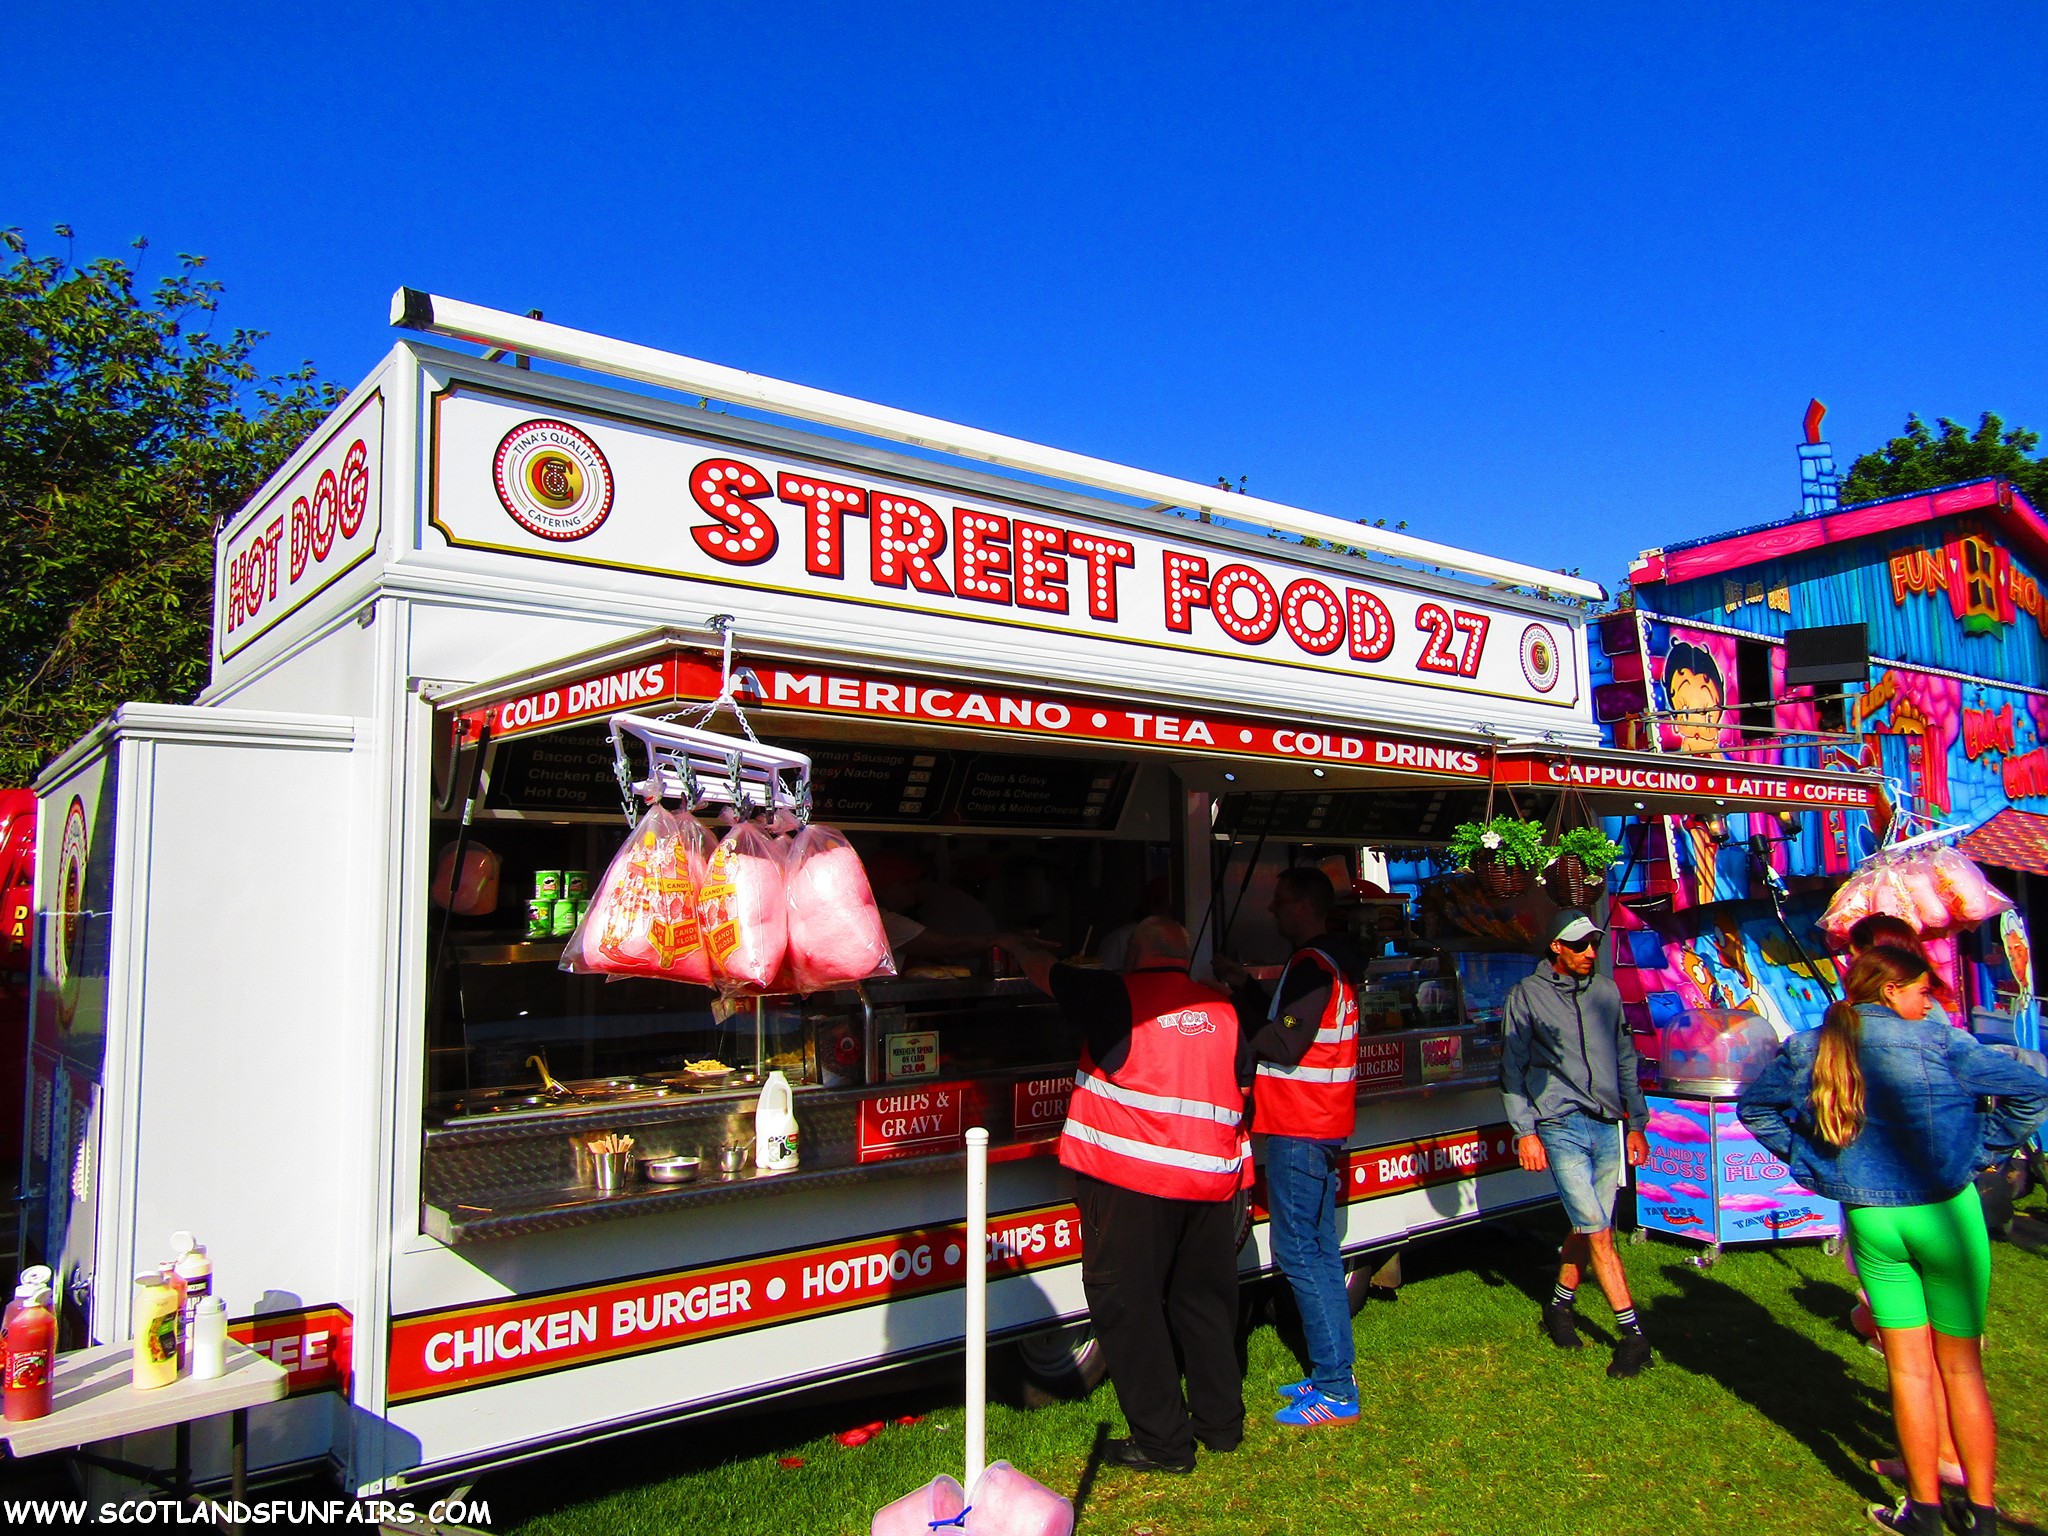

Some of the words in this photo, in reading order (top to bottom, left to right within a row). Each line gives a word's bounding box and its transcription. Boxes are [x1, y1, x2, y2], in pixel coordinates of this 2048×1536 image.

[513, 432, 548, 455] TINA'S
[549, 432, 597, 468] QUALITY
[528, 509, 582, 528] CATERING
[228, 514, 284, 634] HOT
[290, 439, 369, 586] DOG
[689, 457, 1135, 621] STREET
[1162, 549, 1396, 663] FOOD
[1415, 602, 1491, 678] 27
[1889, 546, 1948, 605] FUN
[501, 692, 560, 730] COLD
[567, 664, 665, 714] DRINKS
[725, 666, 1071, 730] AMERICANO
[1125, 712, 1215, 745] TEA
[1272, 729, 1363, 761] COLD
[1375, 741, 1479, 774] DRINKS
[532, 750, 582, 764] Bacon
[852, 752, 905, 766] Sausage
[528, 768, 590, 783] Chicken
[844, 768, 890, 780] Nachos
[976, 772, 1005, 784] Chips
[1008, 773, 1016, 783] &
[1018, 774, 1048, 787] Gravy
[1548, 763, 1697, 792] CAPPUCCINO
[1726, 777, 1787, 798] LATTE
[1803, 784, 1867, 803] COFFEE
[524, 786, 552, 798] Hot
[556, 787, 587, 801] Dog
[971, 787, 1001, 799] Chips
[1004, 788, 1011, 798] &
[1014, 788, 1051, 800] Cheese
[838, 799, 873, 812] Curry
[967, 801, 996, 814] Chips
[998, 803, 1006, 813] &
[1008, 803, 1042, 814] Melted
[1043, 805, 1079, 817] Cheese
[704, 887, 725, 897] CANDY
[674, 927, 697, 938] CANDY
[677, 934, 698, 945] FLOSS
[714, 928, 735, 944] CANDY
[717, 936, 734, 951] FLOSS
[1356, 1042, 1399, 1058] HICKEN
[1358, 1058, 1400, 1077] URGERS
[1027, 1076, 1074, 1097] CHIPS
[876, 1092, 930, 1115] CHIPS
[936, 1090, 950, 1108] &
[881, 1113, 944, 1138] GRAVY
[1379, 1151, 1430, 1183] BACON
[1434, 1141, 1488, 1169] BURGER
[1648, 1145, 1708, 1165] ANDY
[425, 1305, 598, 1374] CHICKEN
[612, 1278, 752, 1336] BURGER
[802, 1244, 932, 1298] HOTDOG
[1054, 1219, 1070, 1248] &
